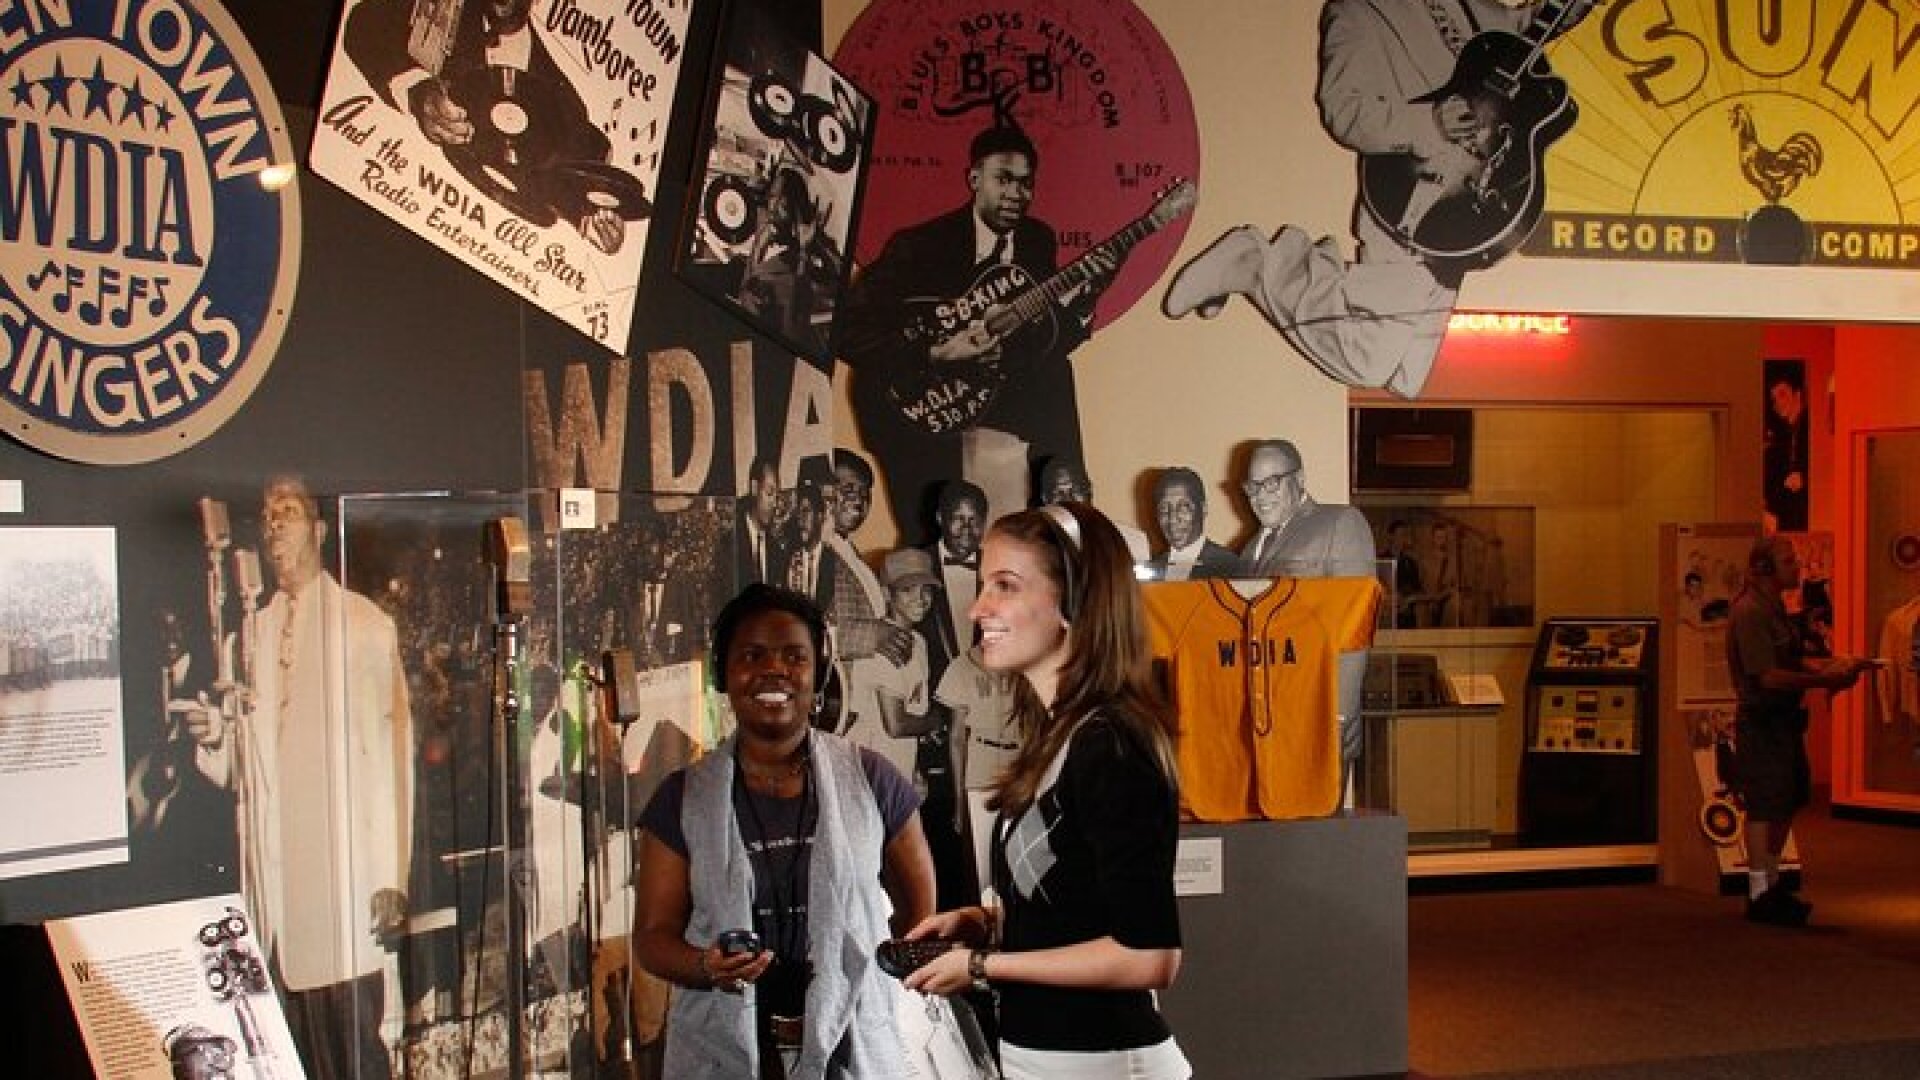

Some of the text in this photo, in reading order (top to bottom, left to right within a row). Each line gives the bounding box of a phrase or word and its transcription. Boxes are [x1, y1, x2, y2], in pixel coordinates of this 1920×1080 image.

[0, 116, 203, 267] WDIA
[360, 158, 420, 215] Radio
[418, 163, 486, 229] WDIA
[1552, 220, 1920, 260] RECORD COMP
[0, 294, 241, 428] SINGERS
[523, 340, 863, 534] WDIA
